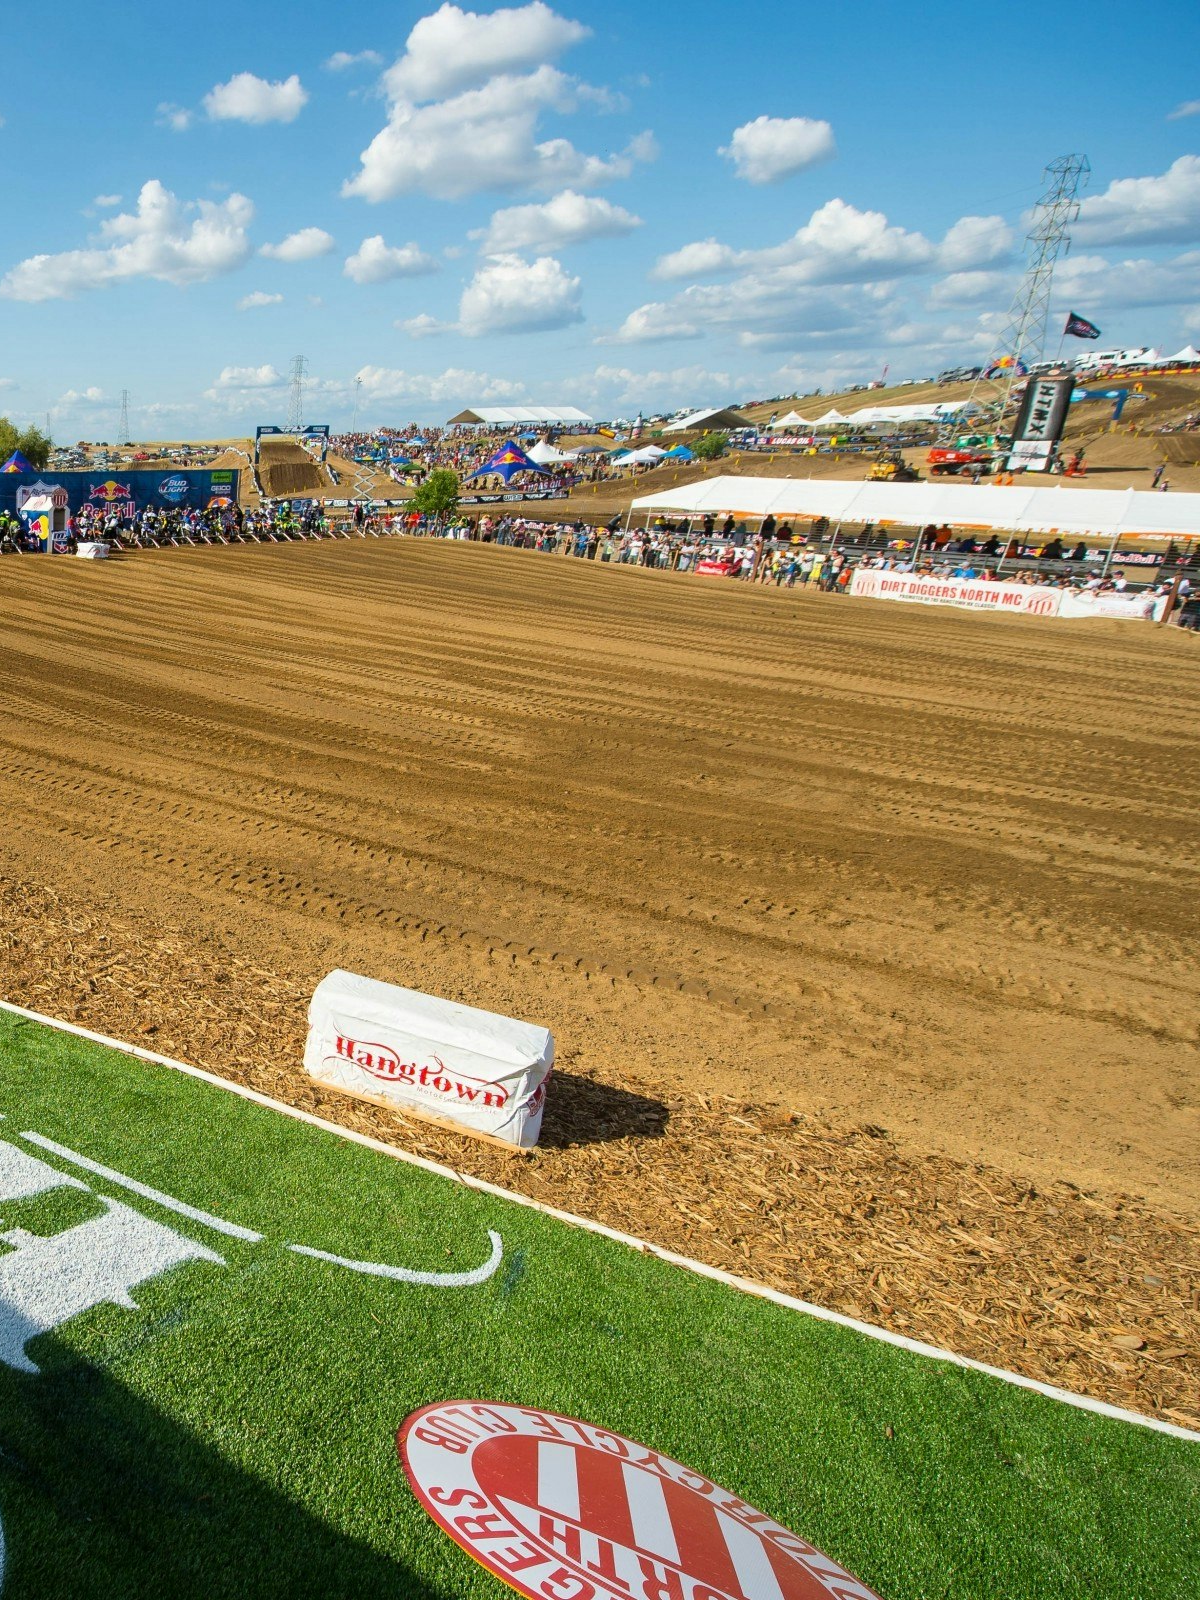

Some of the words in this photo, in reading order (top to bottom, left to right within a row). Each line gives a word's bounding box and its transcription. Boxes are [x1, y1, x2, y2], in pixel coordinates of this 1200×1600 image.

[168, 479, 187, 487] BUD
[881, 580, 908, 593] DIRT
[908, 583, 958, 599] DIGGERS
[960, 588, 1000, 603] NORTH
[1002, 592, 1023, 606] MC
[324, 1022, 510, 1110] Hangtown
[414, 1405, 518, 1455] CLUB
